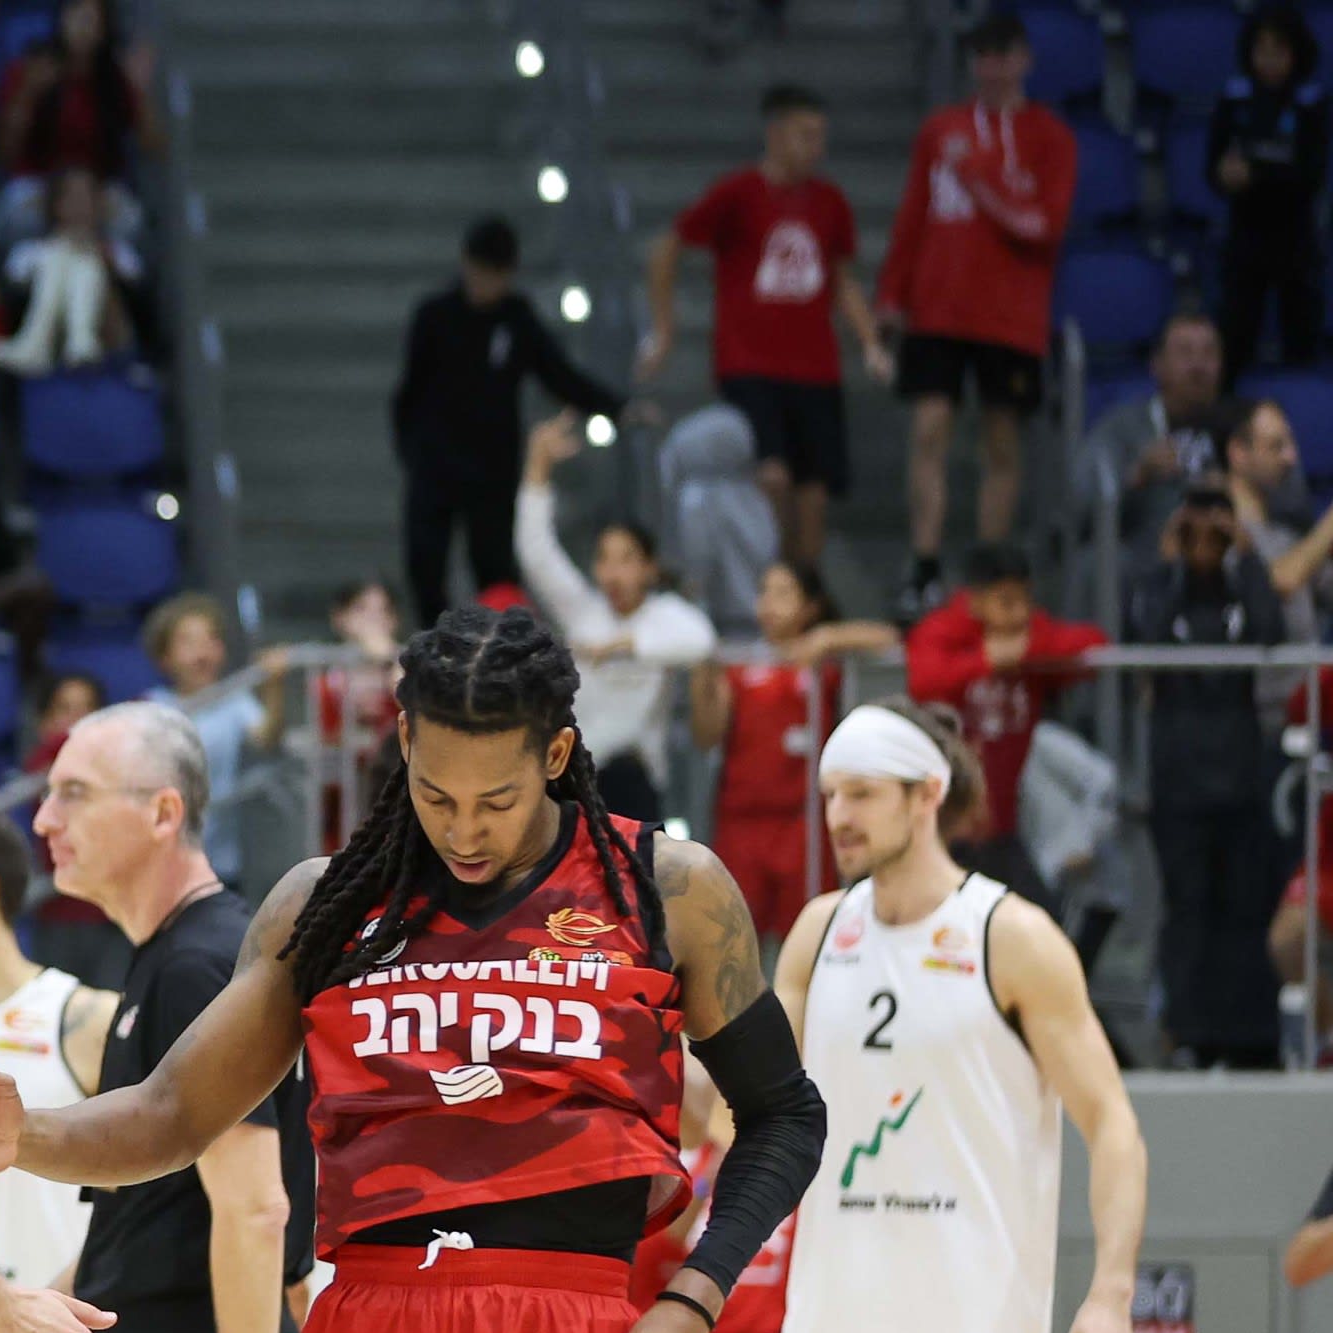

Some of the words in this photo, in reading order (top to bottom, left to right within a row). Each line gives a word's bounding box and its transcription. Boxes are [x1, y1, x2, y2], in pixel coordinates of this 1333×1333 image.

[351, 991, 458, 1058] יהב
[471, 991, 603, 1064] בנק
[862, 990, 898, 1051] 2
